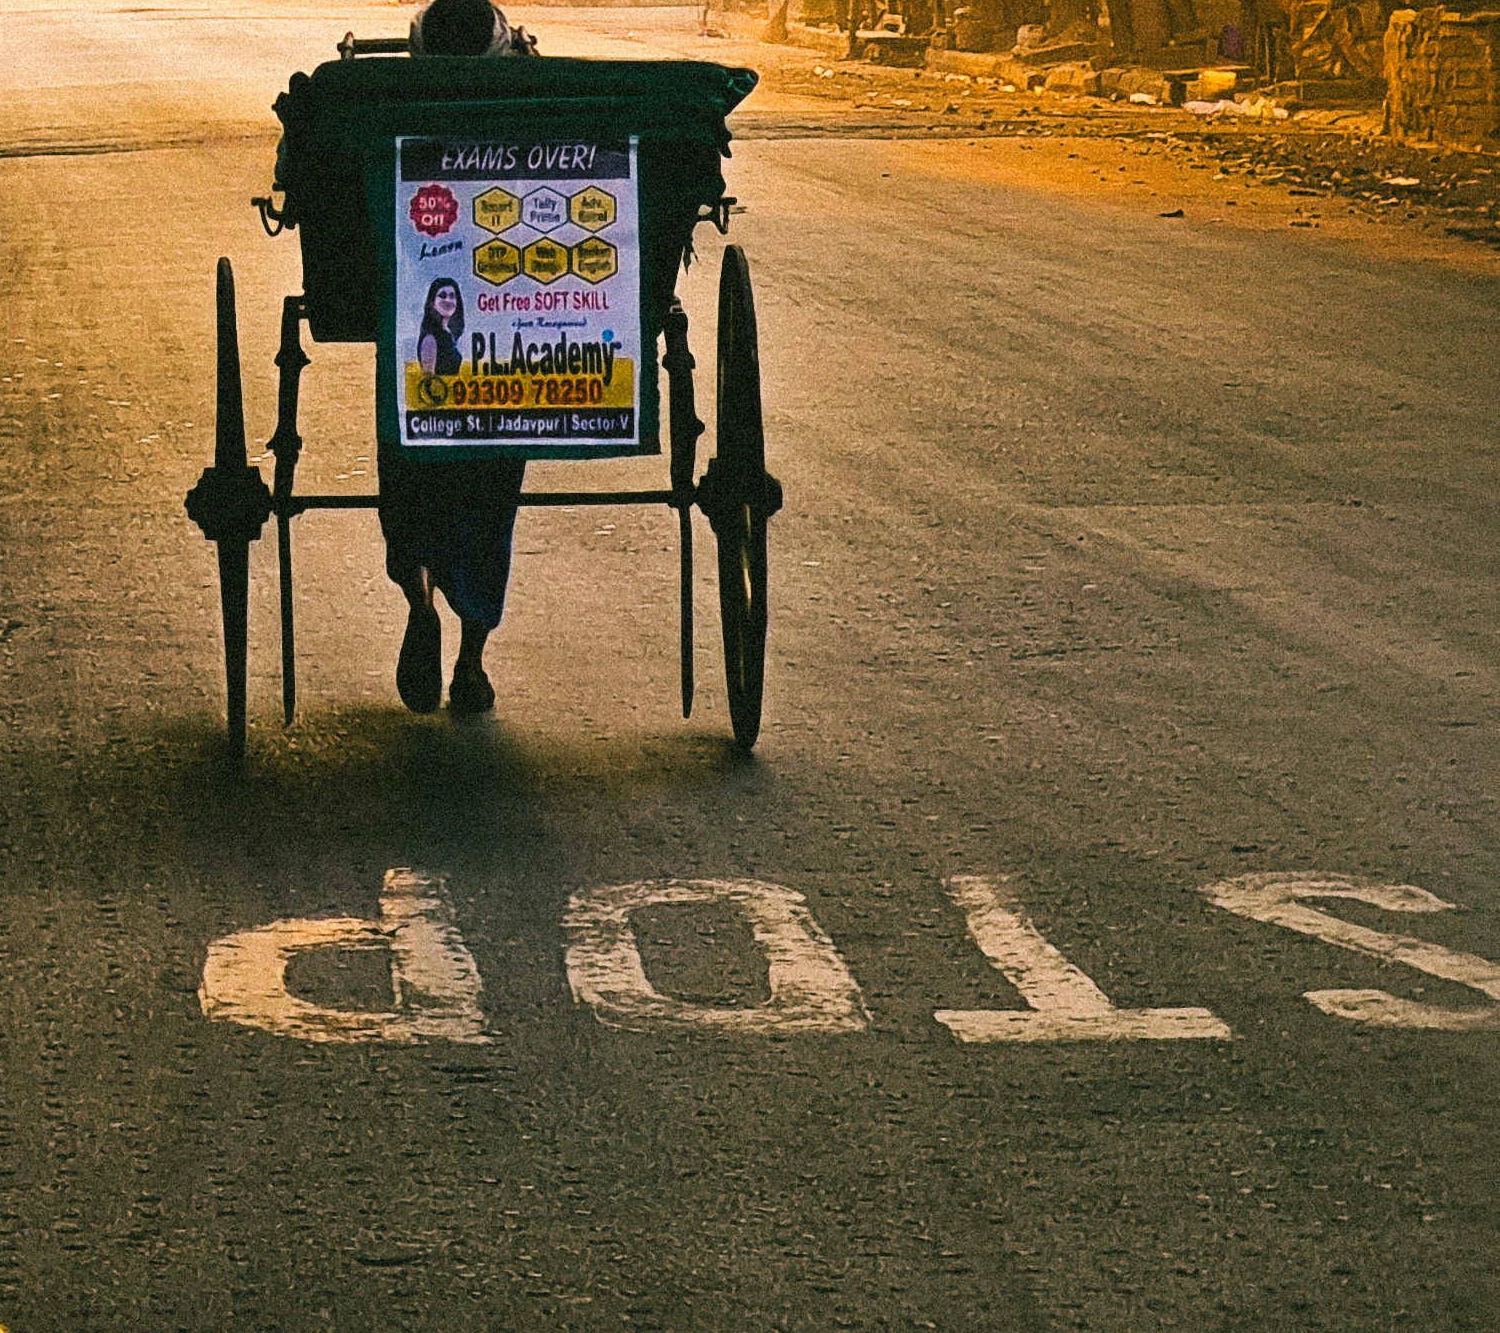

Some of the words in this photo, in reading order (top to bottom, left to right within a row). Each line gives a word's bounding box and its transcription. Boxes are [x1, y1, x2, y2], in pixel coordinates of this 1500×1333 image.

[441, 144, 518, 171] EXAMS
[527, 144, 597, 170] OVER!
[419, 196, 451, 210] 50%
[533, 198, 557, 210] Tally
[420, 240, 463, 260] Learn
[478, 293, 499, 311] Get
[503, 293, 531, 311] Free
[534, 291, 569, 311] SOFT
[573, 290, 609, 310] SKILL
[453, 379, 524, 405] 93309
[531, 378, 603, 405] 78250
[410, 416, 461, 437] College
[467, 414, 484, 432] St.
[497, 415, 560, 436] Jadavpur
[198, 865, 1500, 1045] STOP
